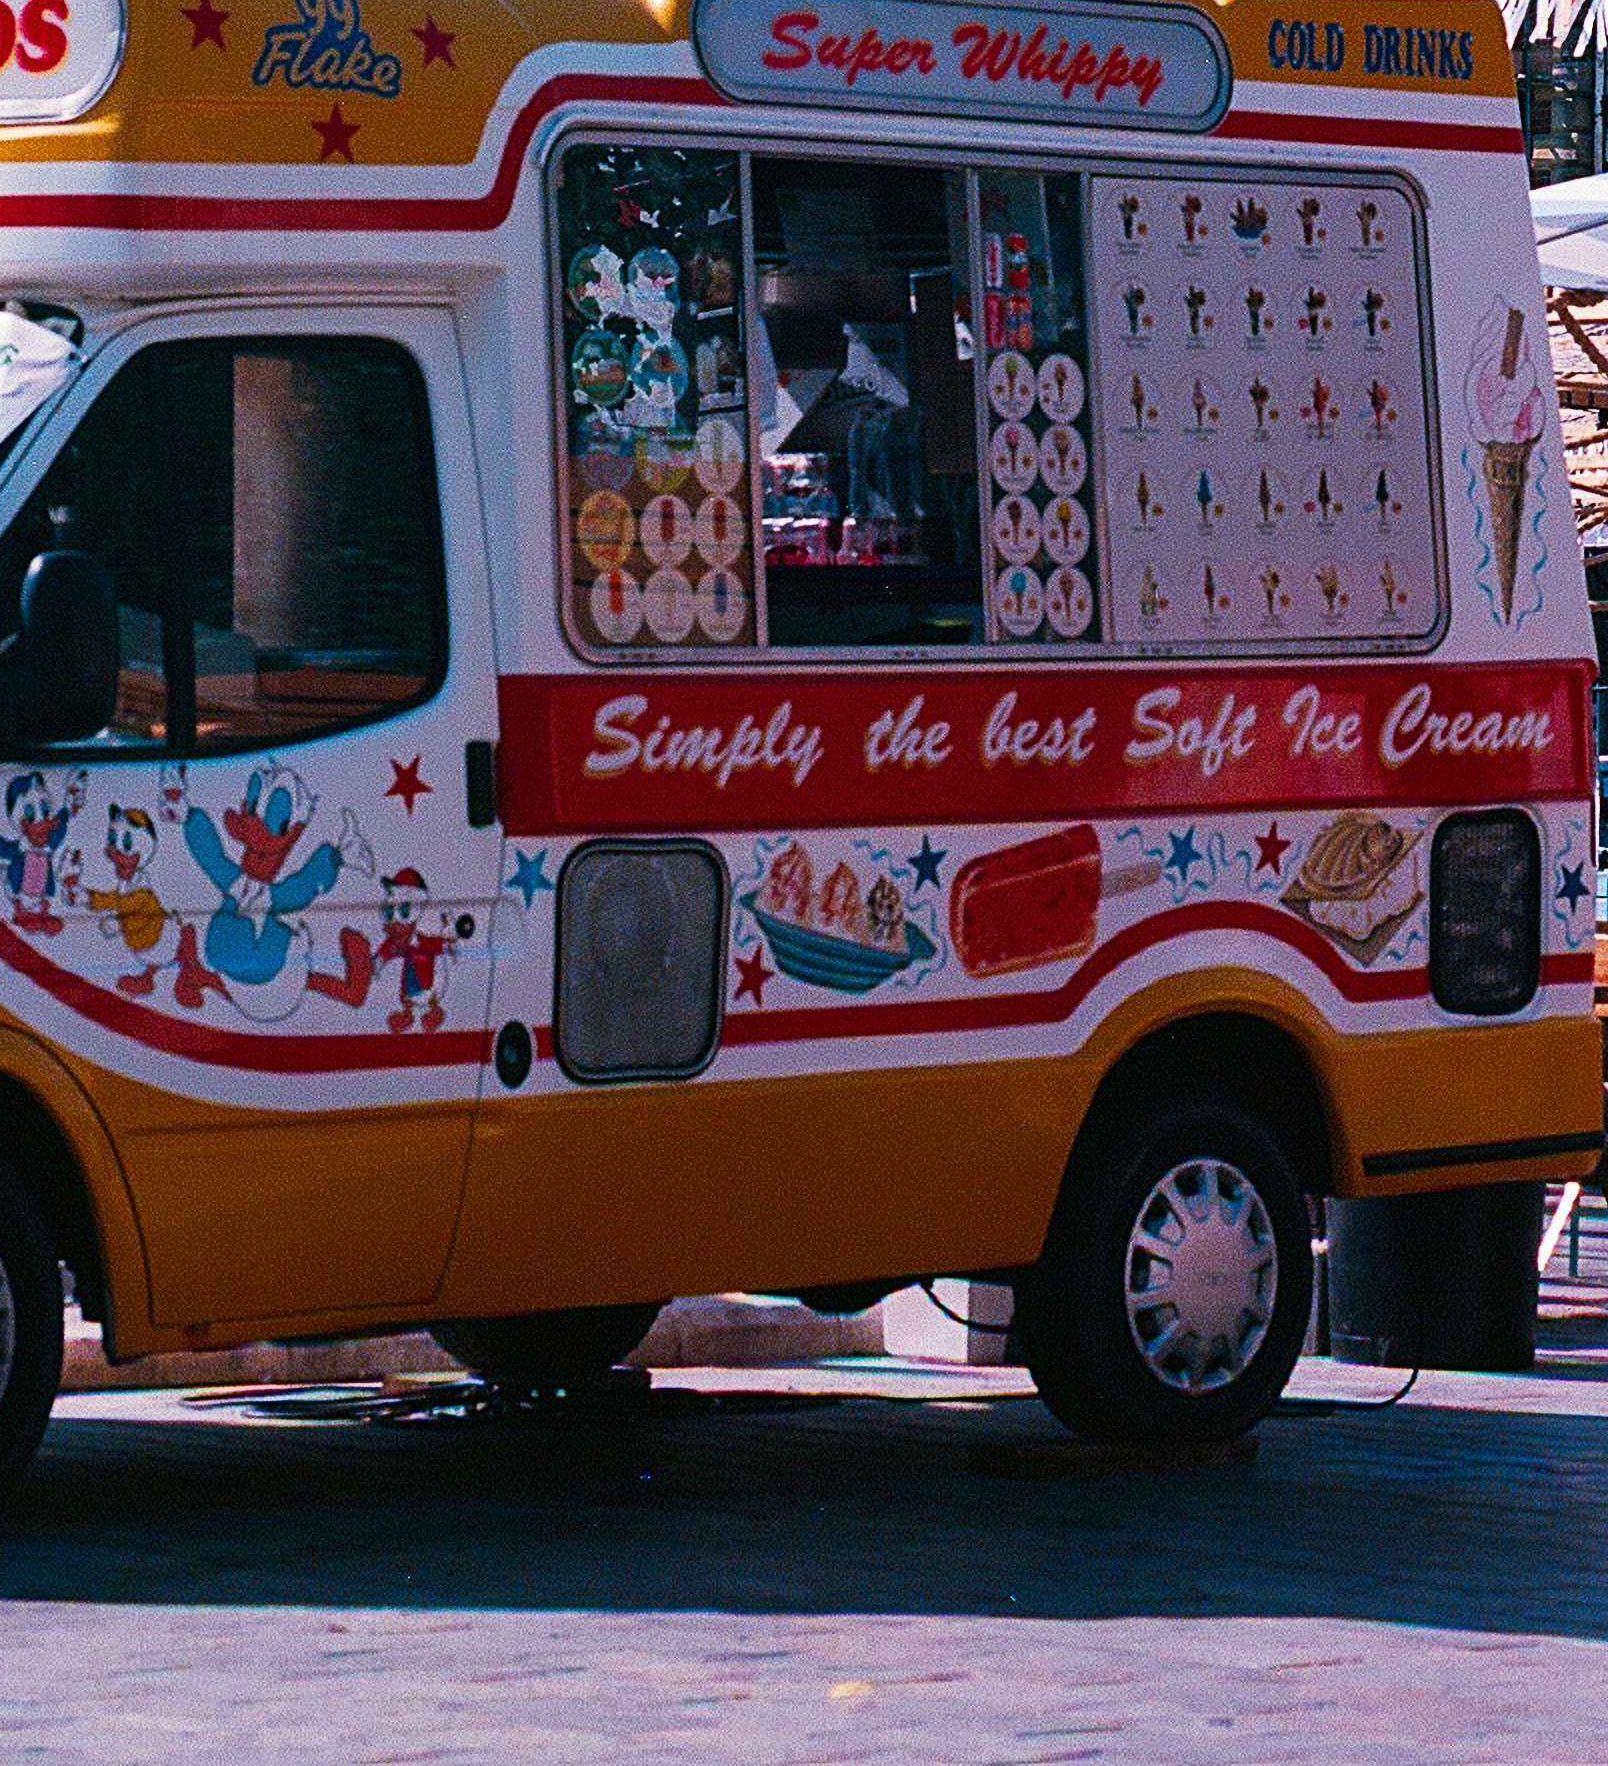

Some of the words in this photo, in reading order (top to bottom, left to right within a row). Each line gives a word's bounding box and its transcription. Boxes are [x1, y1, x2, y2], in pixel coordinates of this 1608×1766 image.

[252, 24, 402, 98] Flake
[762, 11, 936, 86] Super
[952, 21, 1163, 107] Whippy
[1268, 18, 1345, 73] COLD
[1364, 24, 1473, 80] DRINKS
[583, 693, 825, 788] Simply
[863, 695, 954, 775] the
[981, 691, 1098, 767] best
[1125, 685, 1258, 779] Soft
[1281, 683, 1362, 757] Ice
[1378, 683, 1556, 768] Cream
